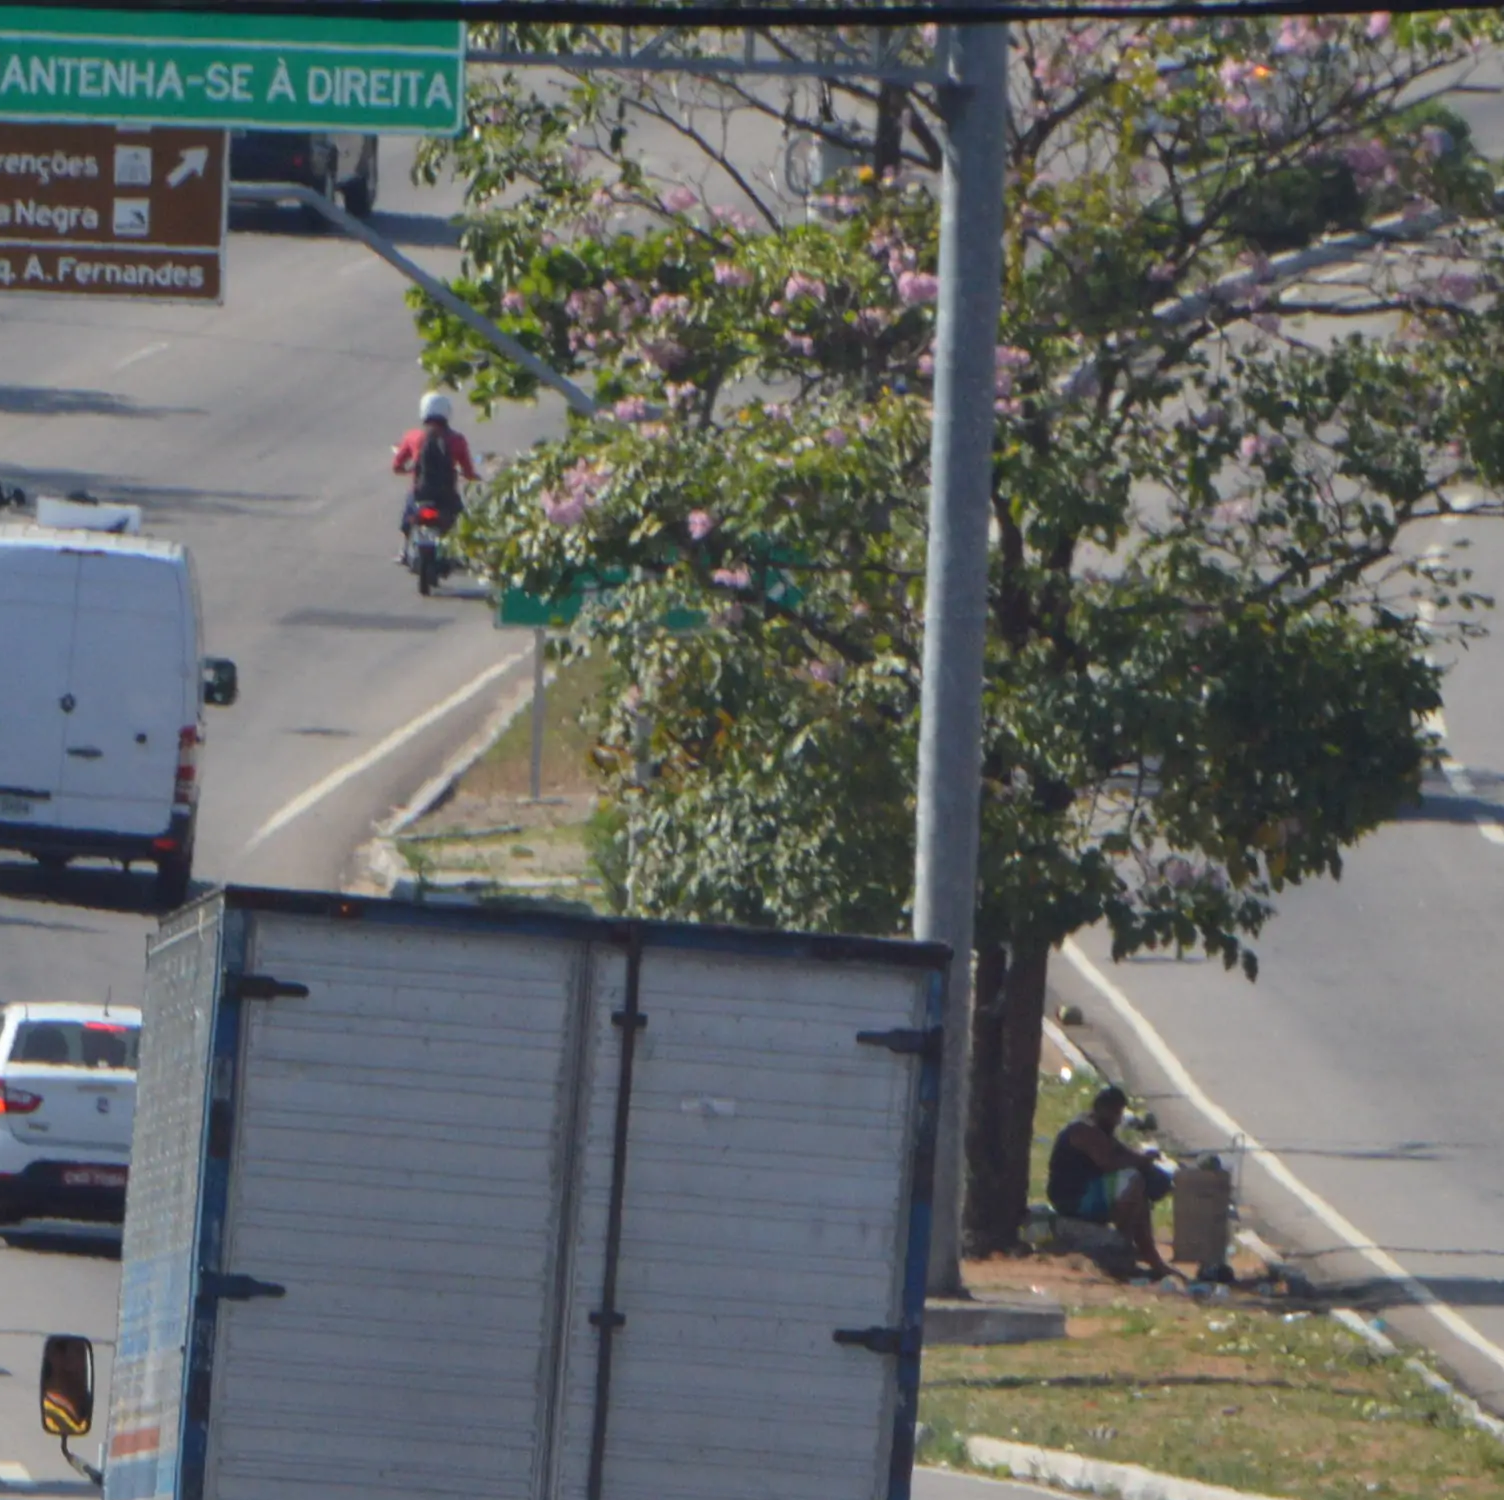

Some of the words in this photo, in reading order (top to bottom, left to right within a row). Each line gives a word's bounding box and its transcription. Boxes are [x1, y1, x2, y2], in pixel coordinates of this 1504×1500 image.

[265, 57, 298, 103] À
[306, 65, 454, 110] DIREITA
[15, 200, 99, 235] Negra
[24, 256, 52, 282] A.
[57, 255, 205, 289] Fernandes
